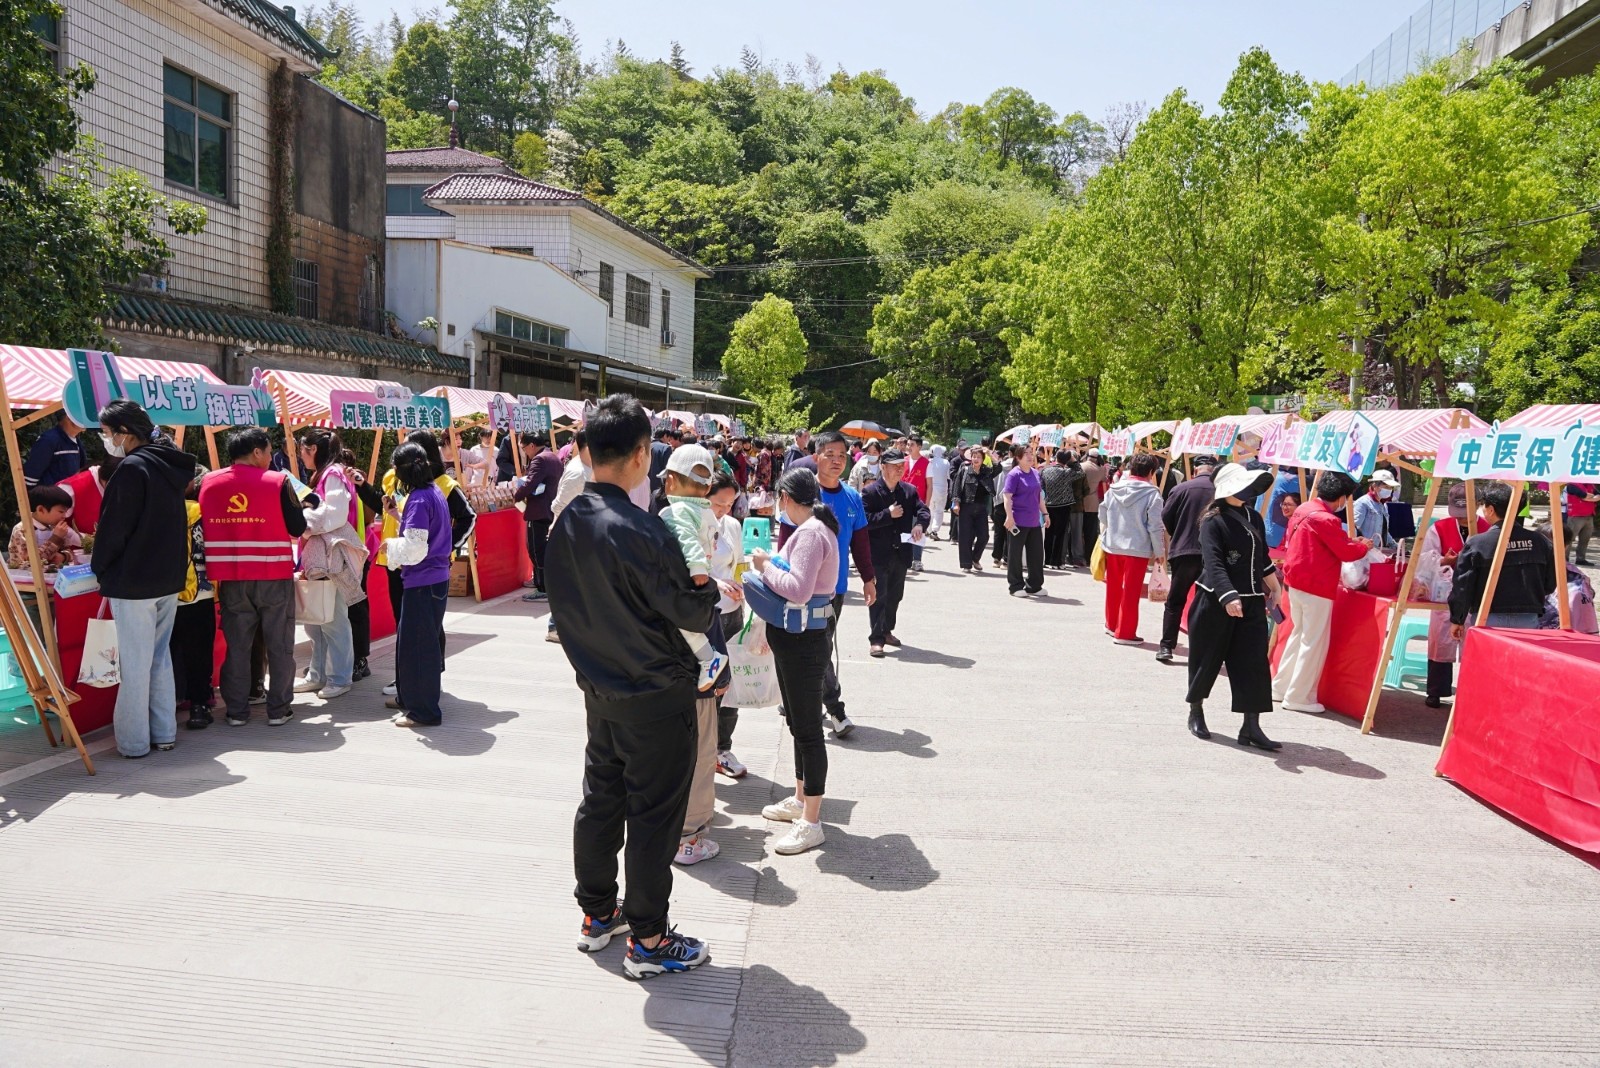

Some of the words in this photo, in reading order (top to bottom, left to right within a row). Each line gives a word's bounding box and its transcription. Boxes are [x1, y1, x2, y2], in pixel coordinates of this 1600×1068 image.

[139, 374, 256, 427] 以书换绿
[341, 402, 442, 429] 柯繁興非遗美食
[1265, 422, 1336, 463] 公益理发
[1457, 432, 1600, 477] 中医保健
